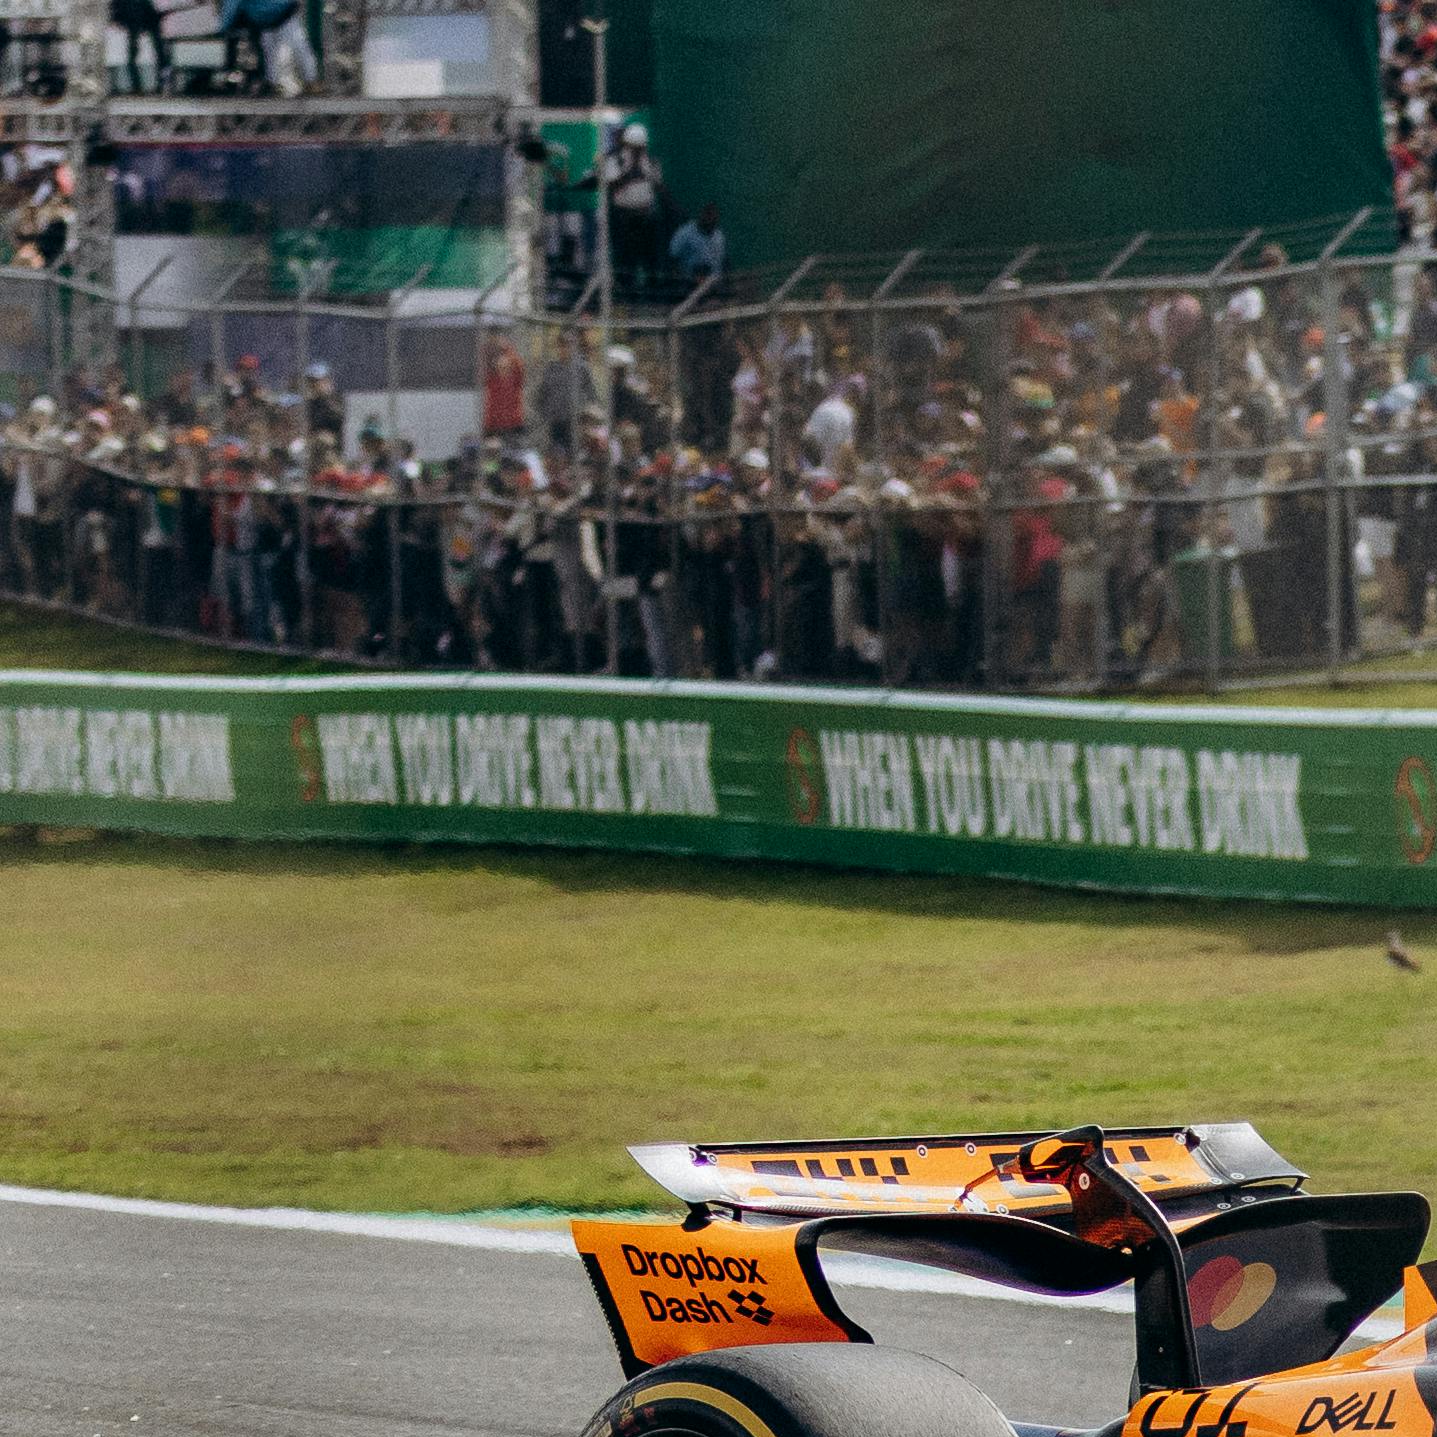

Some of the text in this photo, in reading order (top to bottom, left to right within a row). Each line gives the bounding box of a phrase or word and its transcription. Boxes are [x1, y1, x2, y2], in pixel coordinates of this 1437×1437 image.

[820, 730, 1309, 860] WHEN YOU DRIVE NEVER DRINK
[621, 1244, 768, 1288] Dropbox
[639, 1290, 734, 1324] Dash
[1295, 1388, 1399, 1436] DELL
